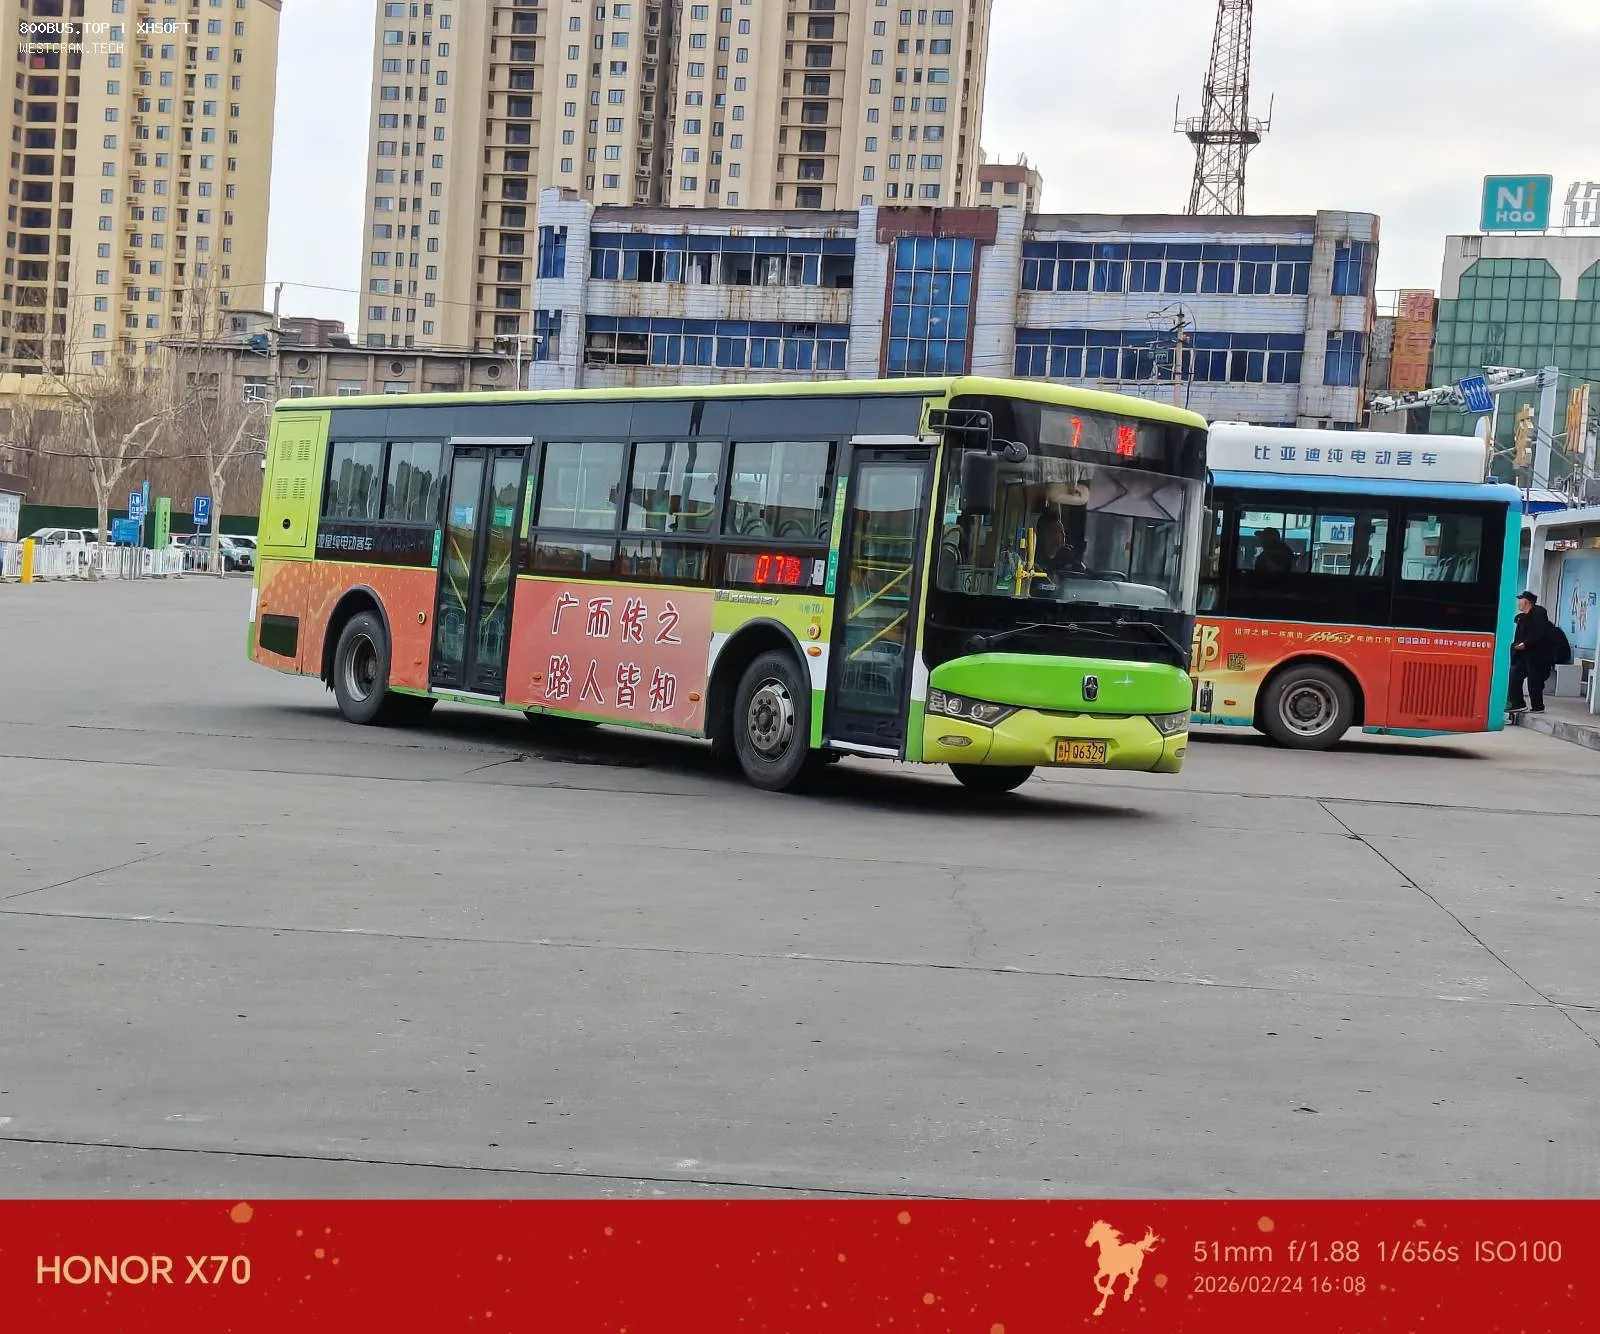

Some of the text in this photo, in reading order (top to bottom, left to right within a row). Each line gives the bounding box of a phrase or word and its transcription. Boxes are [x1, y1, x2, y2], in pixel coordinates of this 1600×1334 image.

[1069, 416, 1083, 448] 7
[1254, 445, 1438, 466] 比亚迪纯电动客车
[754, 553, 801, 585] 07路
[552, 592, 681, 644] 广而传之
[545, 655, 676, 712] 路人皆知
